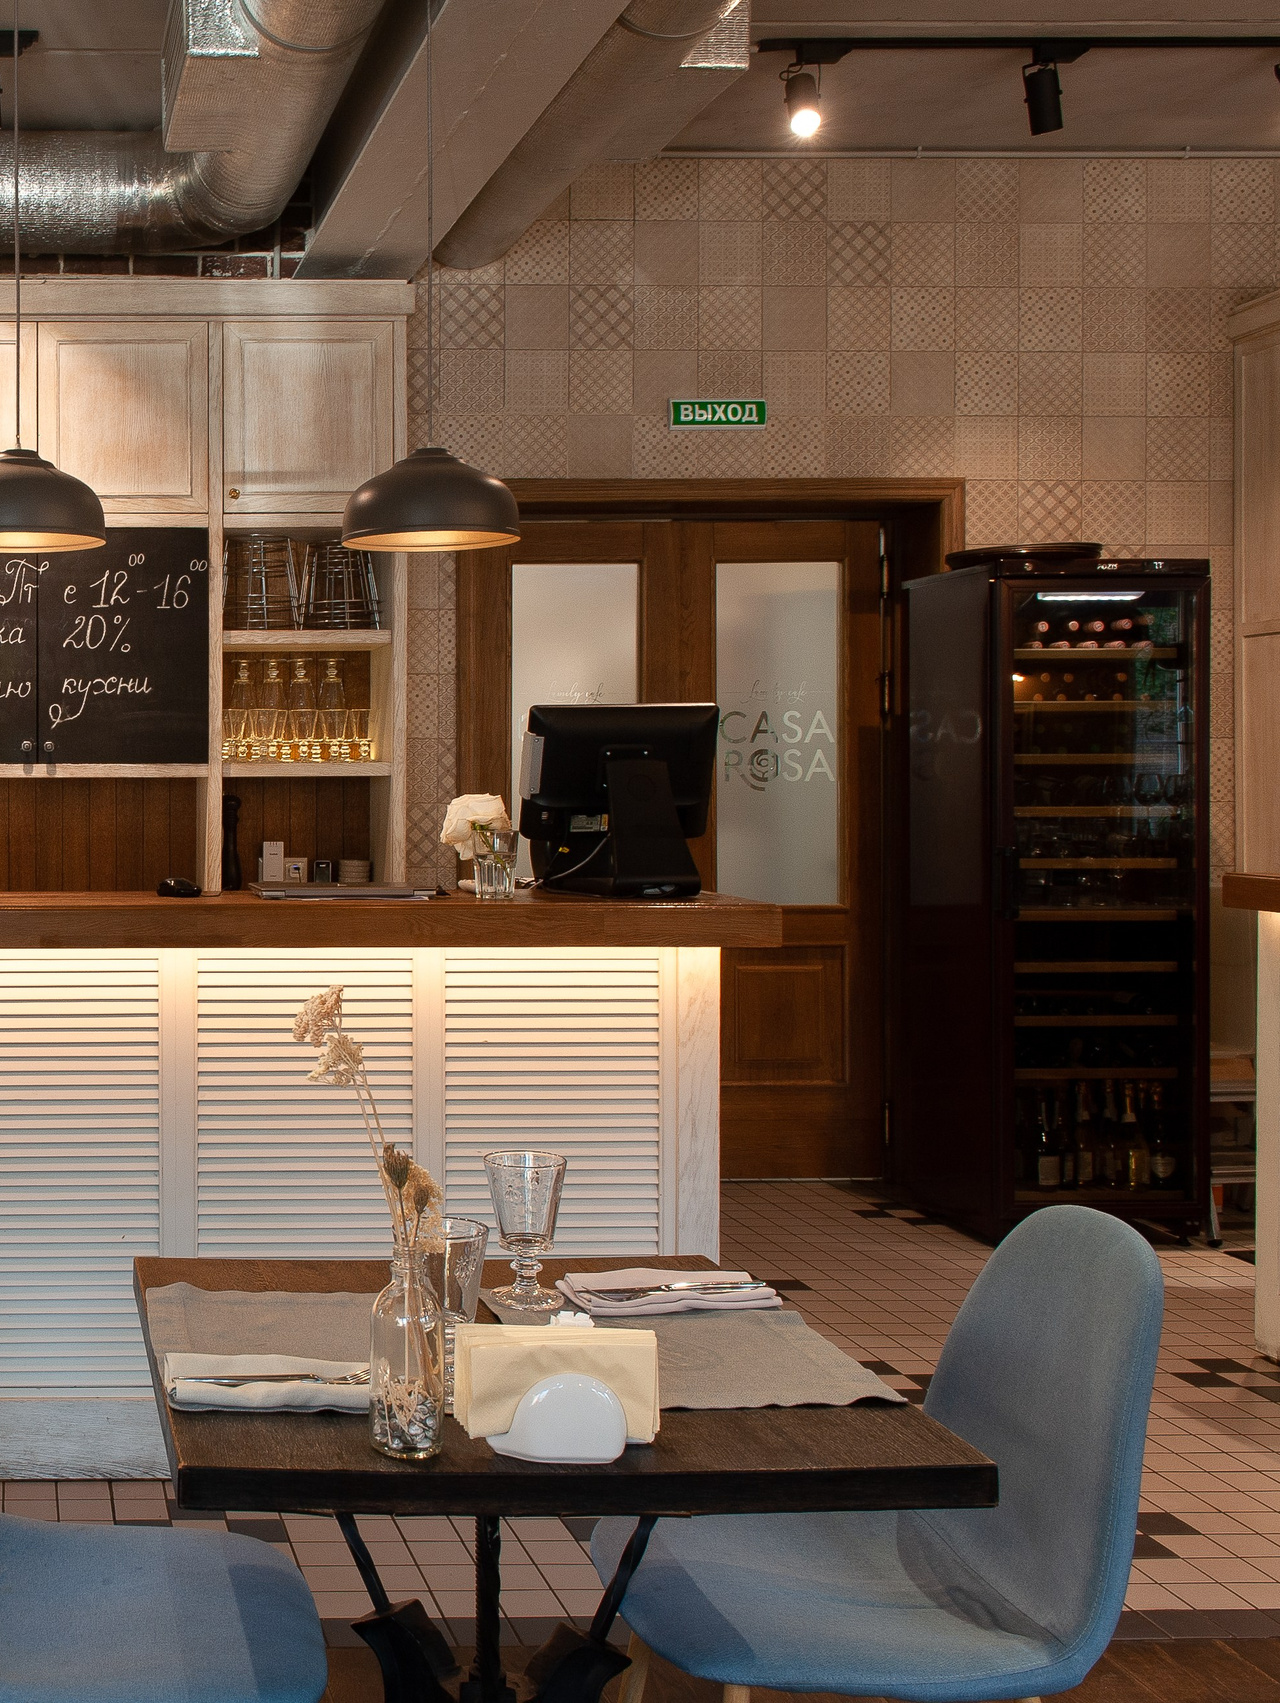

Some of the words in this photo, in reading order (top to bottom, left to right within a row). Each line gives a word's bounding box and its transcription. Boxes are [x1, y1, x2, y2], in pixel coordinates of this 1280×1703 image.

[679, 403, 759, 423] ВЫХОД
[62, 614, 132, 653] 20%
[48, 676, 153, 729] кухни
[718, 709, 836, 744] CASA
[723, 748, 836, 791] ROSA
